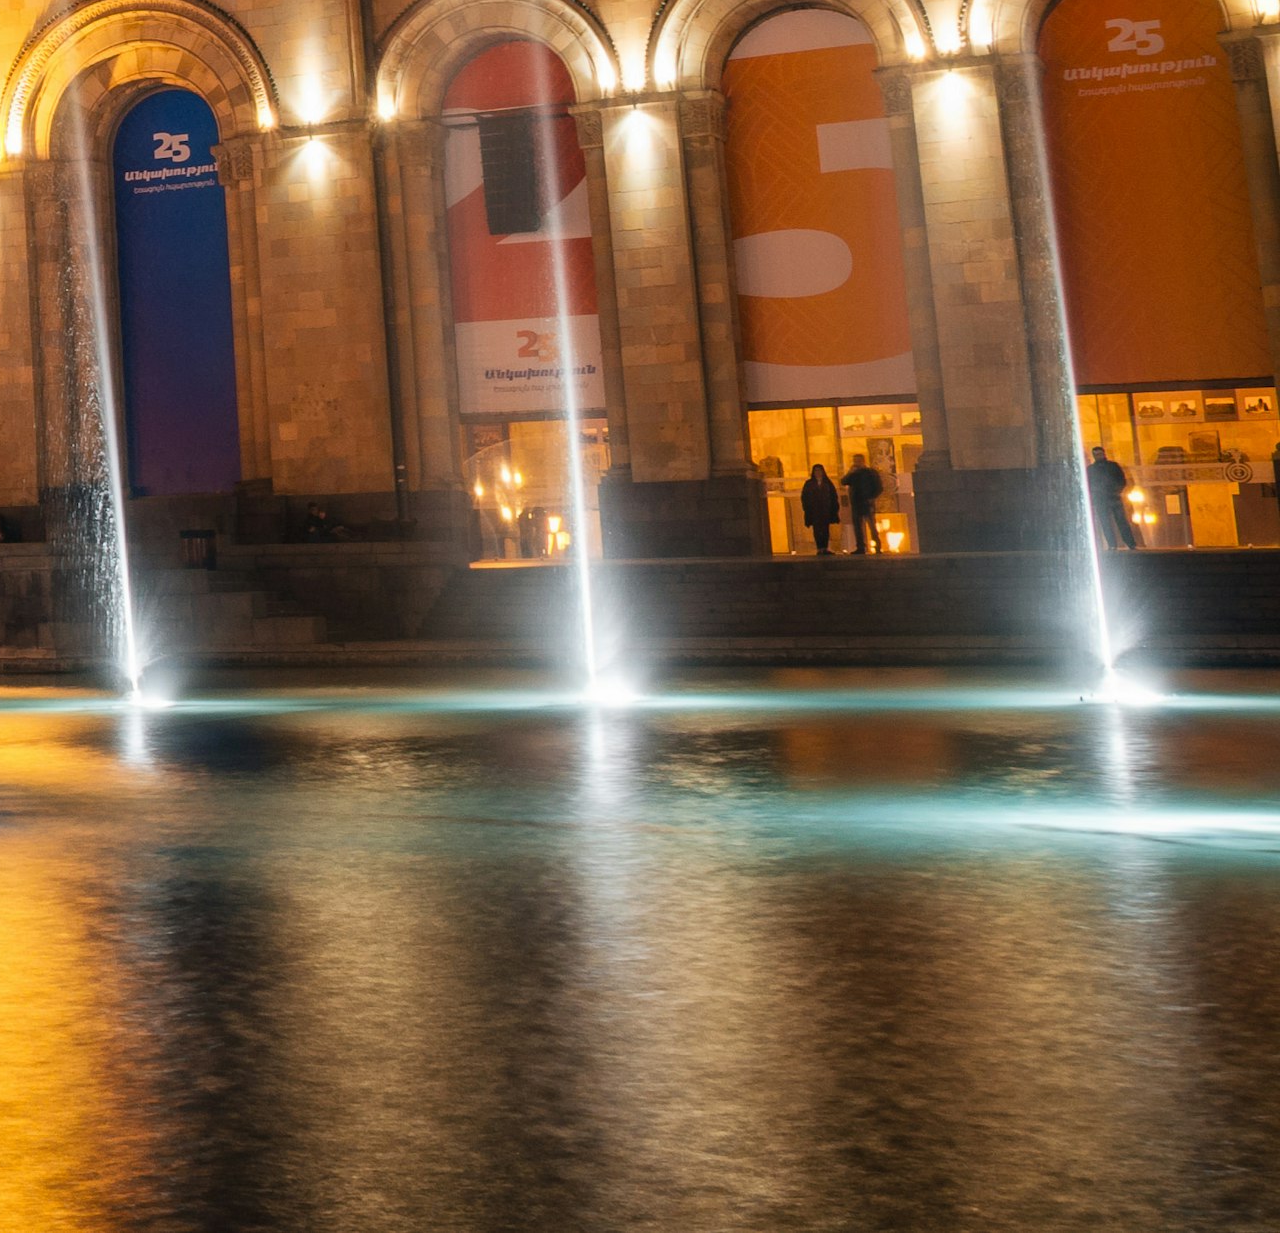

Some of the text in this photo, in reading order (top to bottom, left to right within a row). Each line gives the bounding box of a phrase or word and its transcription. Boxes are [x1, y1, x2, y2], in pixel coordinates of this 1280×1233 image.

[1105, 18, 1165, 56] 25
[1063, 55, 1217, 81] Անկախություն
[153, 133, 191, 163] 25
